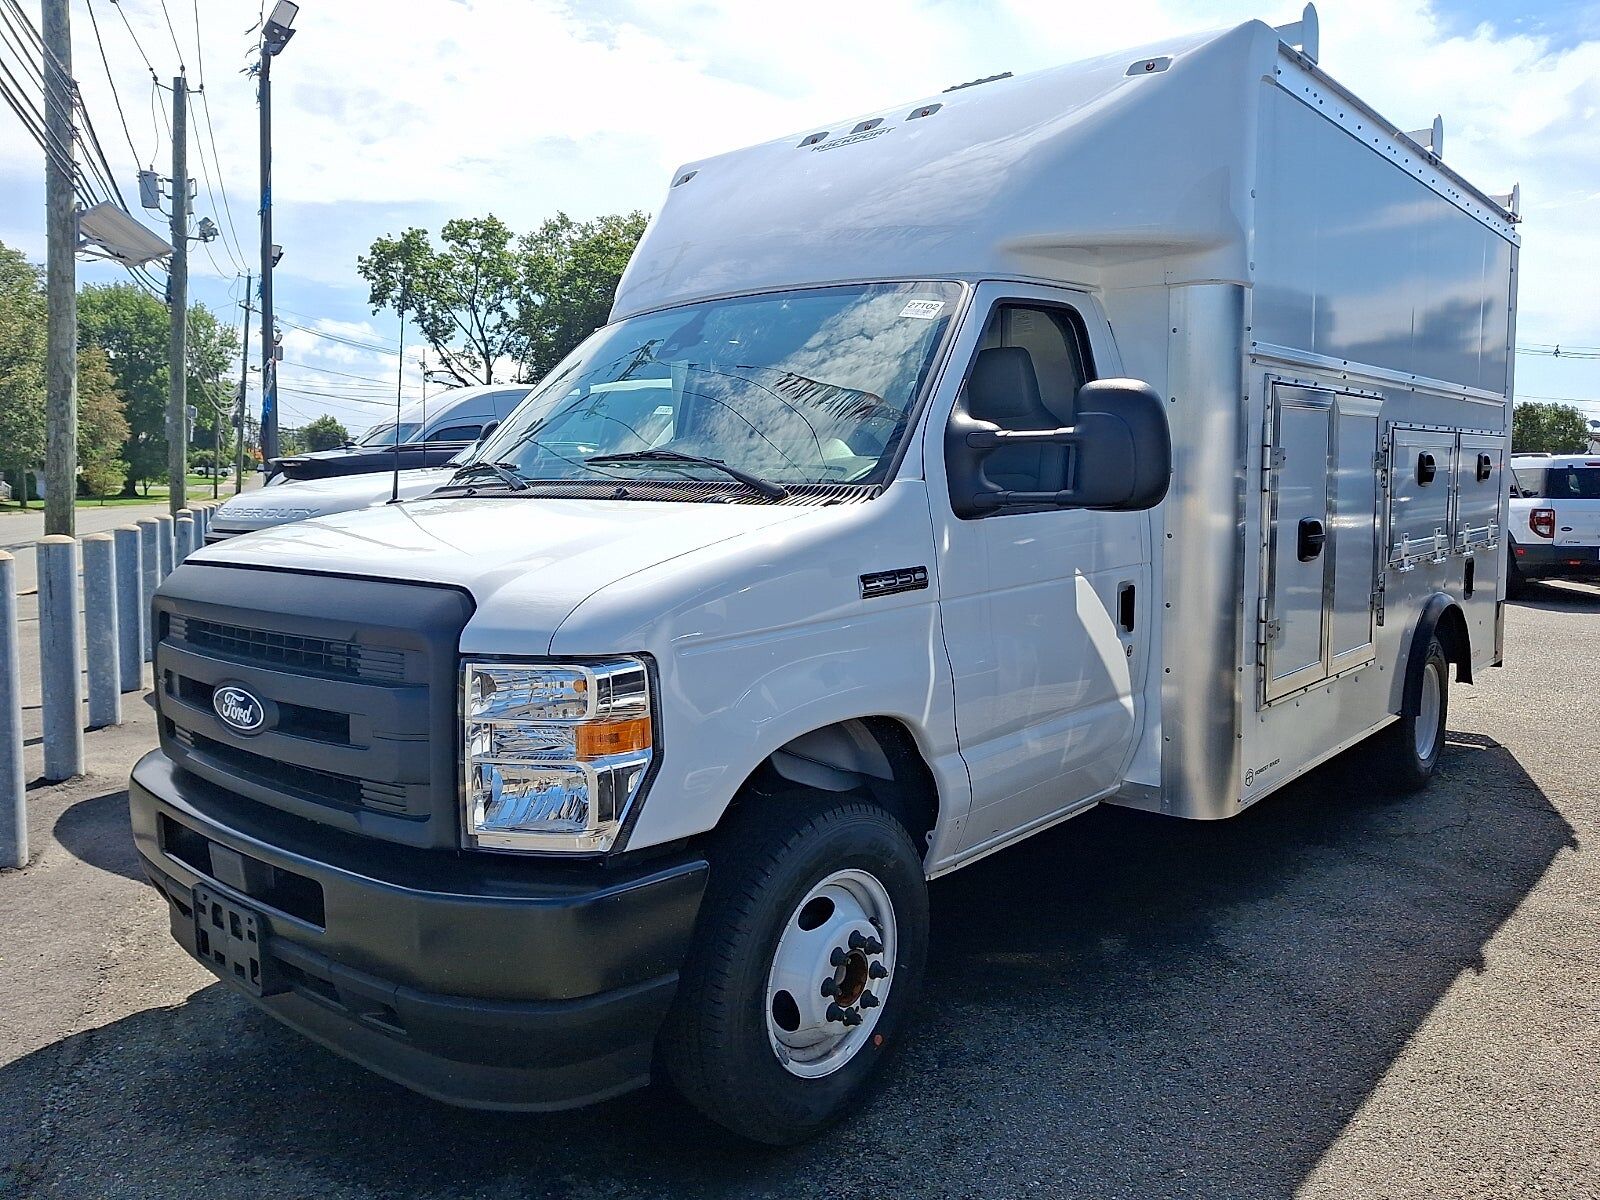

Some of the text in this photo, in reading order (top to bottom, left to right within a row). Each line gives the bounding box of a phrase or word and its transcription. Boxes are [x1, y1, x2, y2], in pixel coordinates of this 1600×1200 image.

[811, 127, 896, 152] ROCKPORT
[217, 507, 320, 519] SUPER DUTY
[222, 691, 253, 724] Ford
